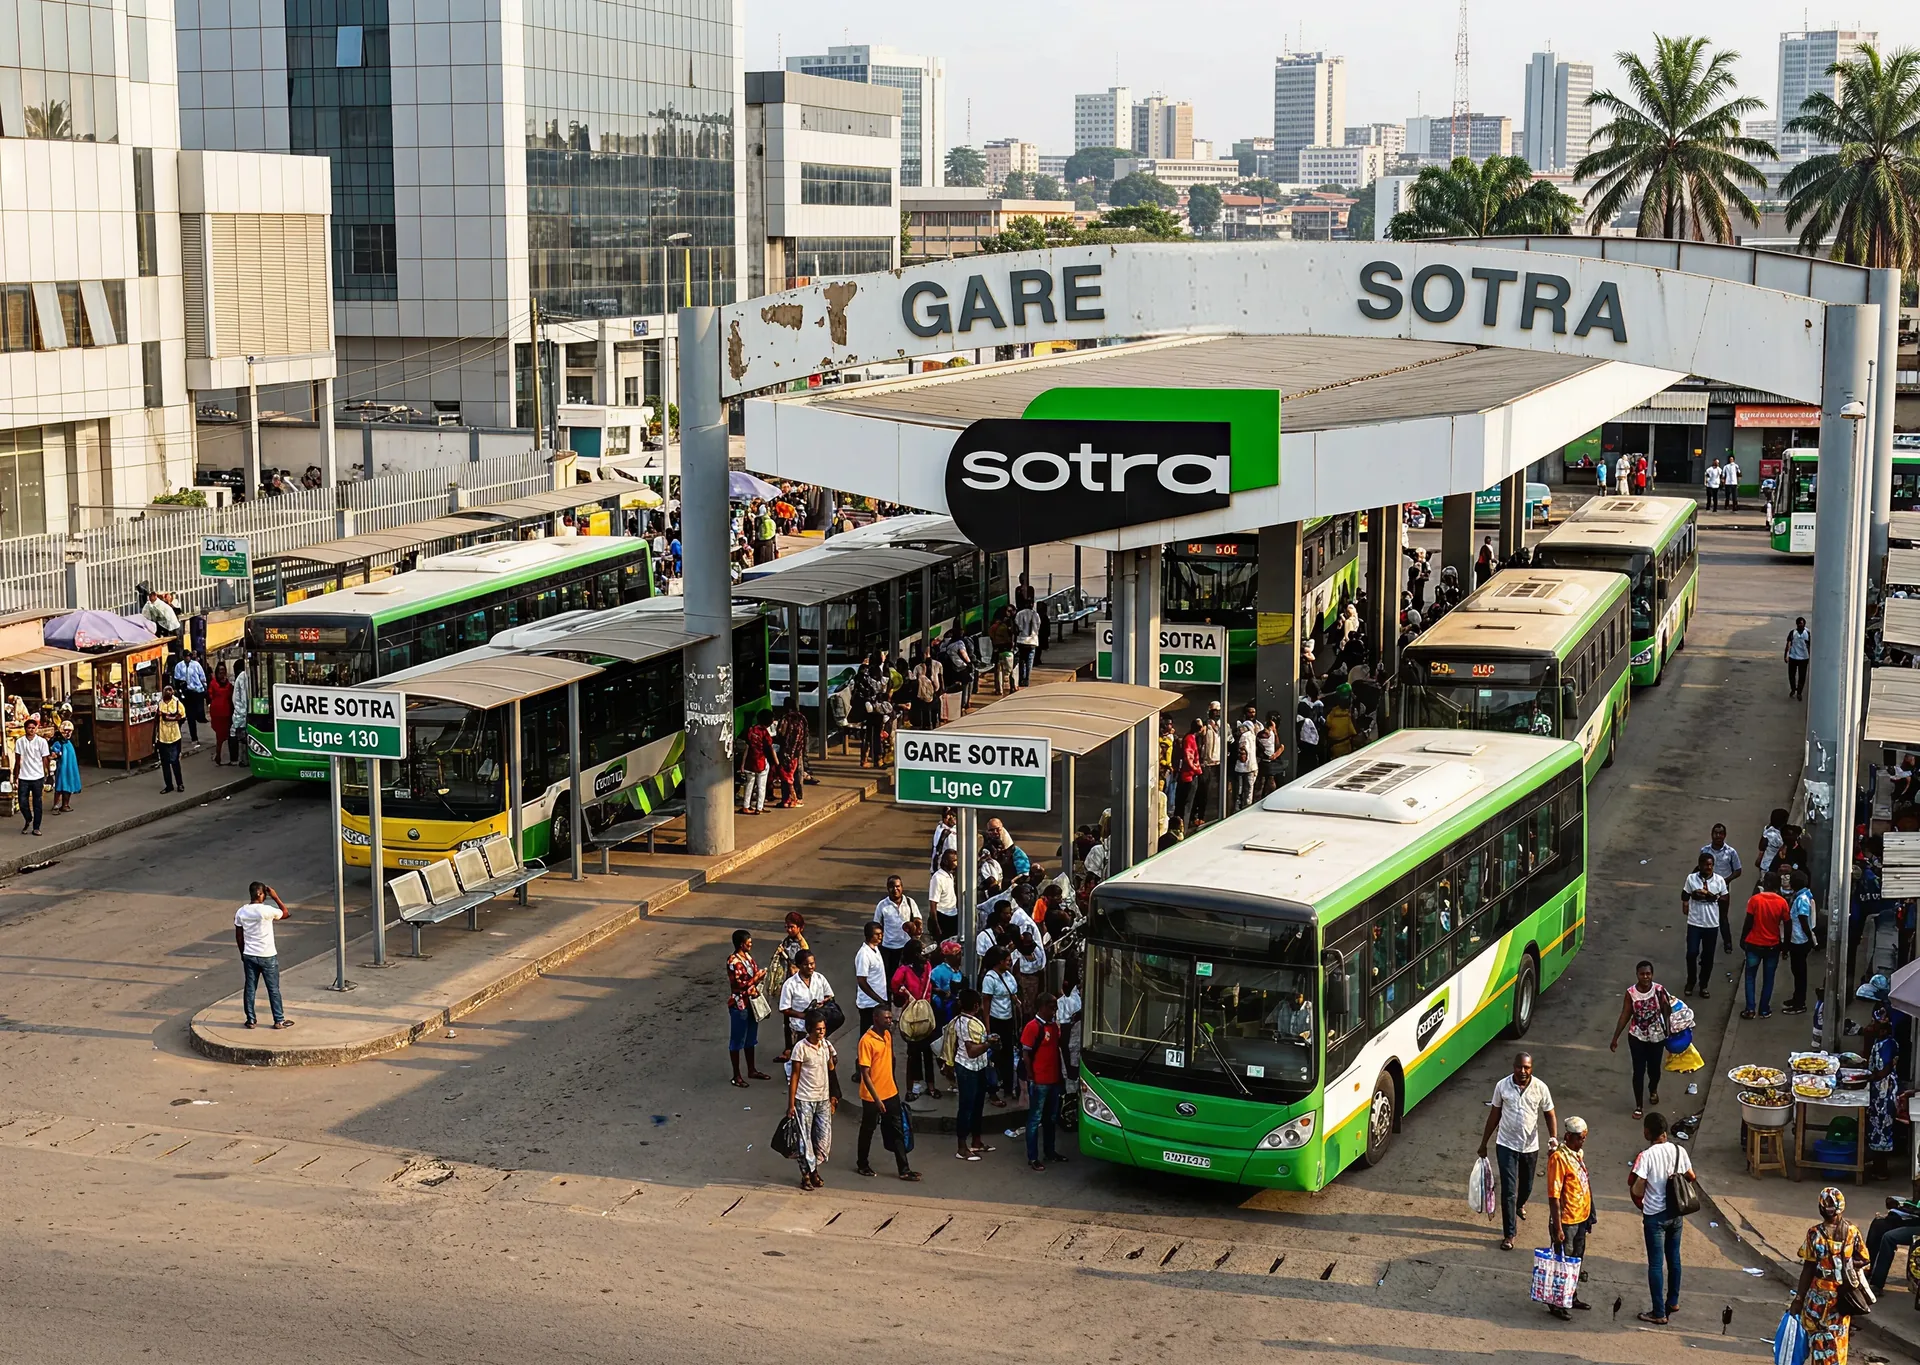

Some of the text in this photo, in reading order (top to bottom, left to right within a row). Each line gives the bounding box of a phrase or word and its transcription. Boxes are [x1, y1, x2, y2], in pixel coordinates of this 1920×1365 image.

[902, 260, 1628, 344] GARE SOTRA
[961, 443, 1230, 494] sotra
[1159, 631, 1216, 650] SOTRA
[1174, 660, 1194, 675] 03
[280, 693, 396, 719] GARE SOTRA
[348, 730, 379, 748] 130
[904, 741, 1040, 768] GARE SOTRA
[989, 780, 1014, 799] 07
